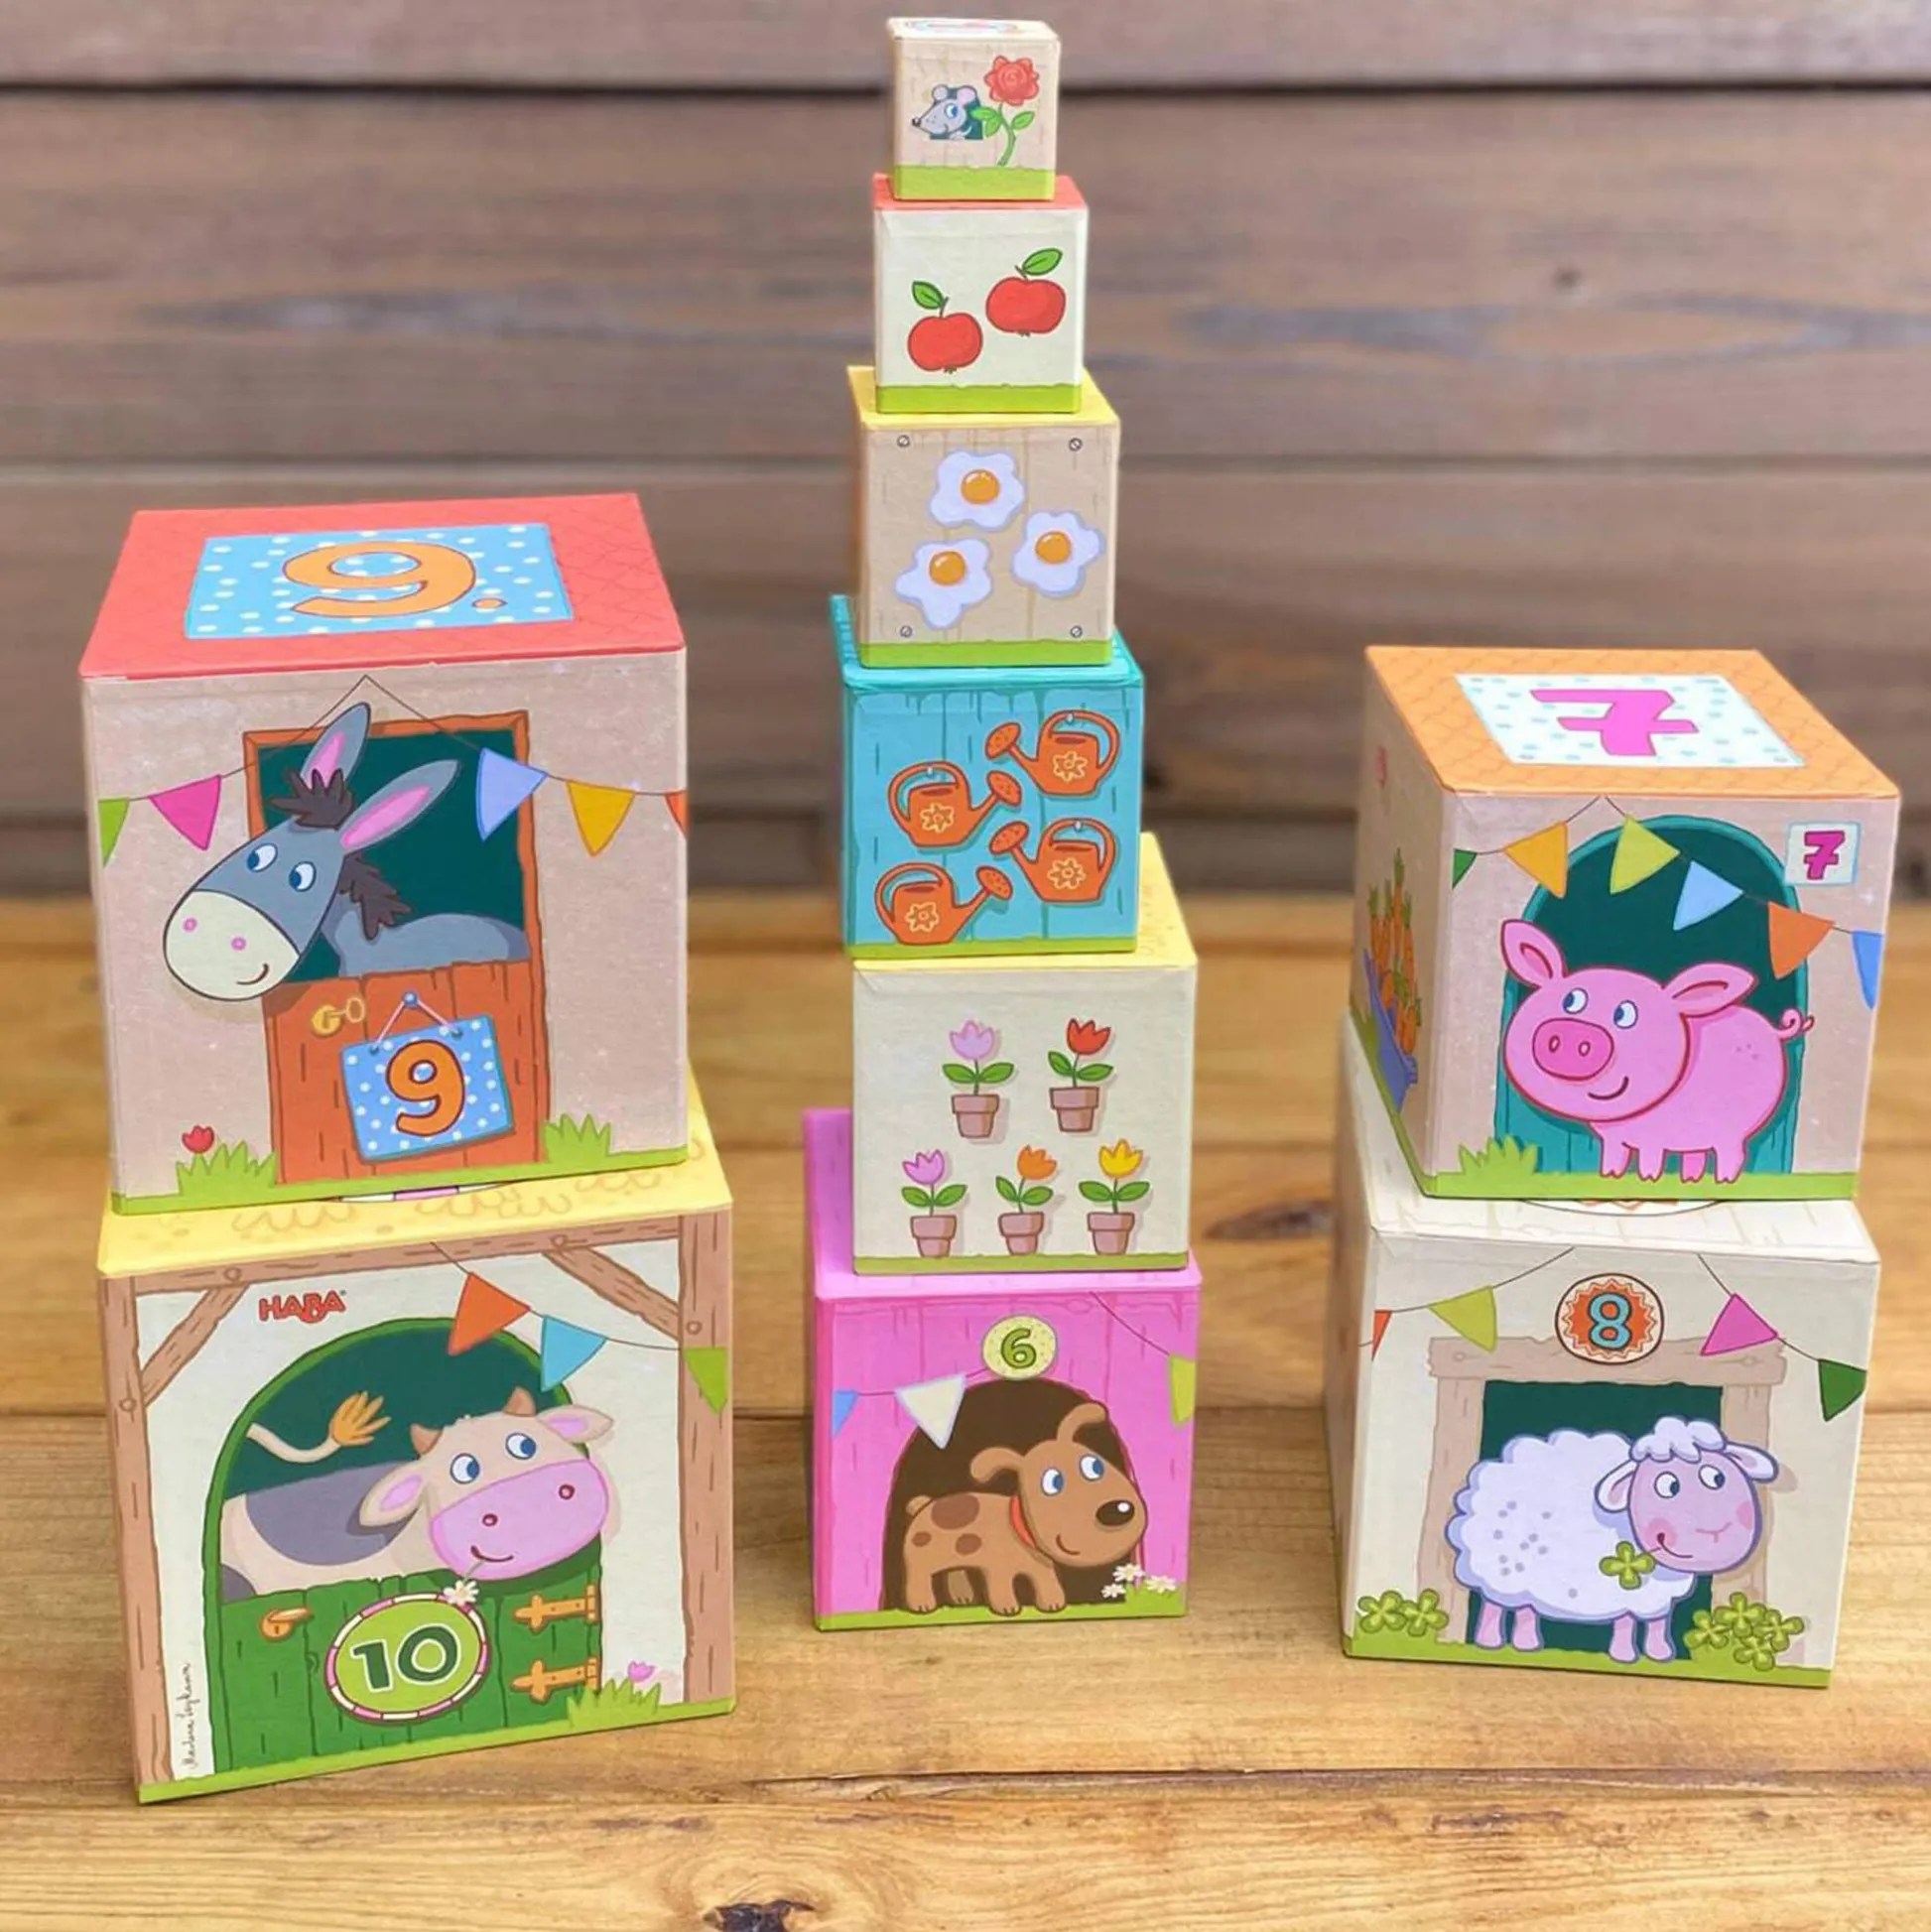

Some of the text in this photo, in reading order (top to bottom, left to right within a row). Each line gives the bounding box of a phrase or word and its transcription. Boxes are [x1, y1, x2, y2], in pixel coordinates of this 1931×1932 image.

[1529, 689, 1699, 756] 7
[1803, 830, 1846, 881] 7
[384, 1039, 465, 1136] 9
[258, 1290, 346, 1324] HABA
[1588, 1292, 1632, 1351] 8
[999, 1328, 1038, 1369] 6
[350, 1622, 461, 1694] 10
